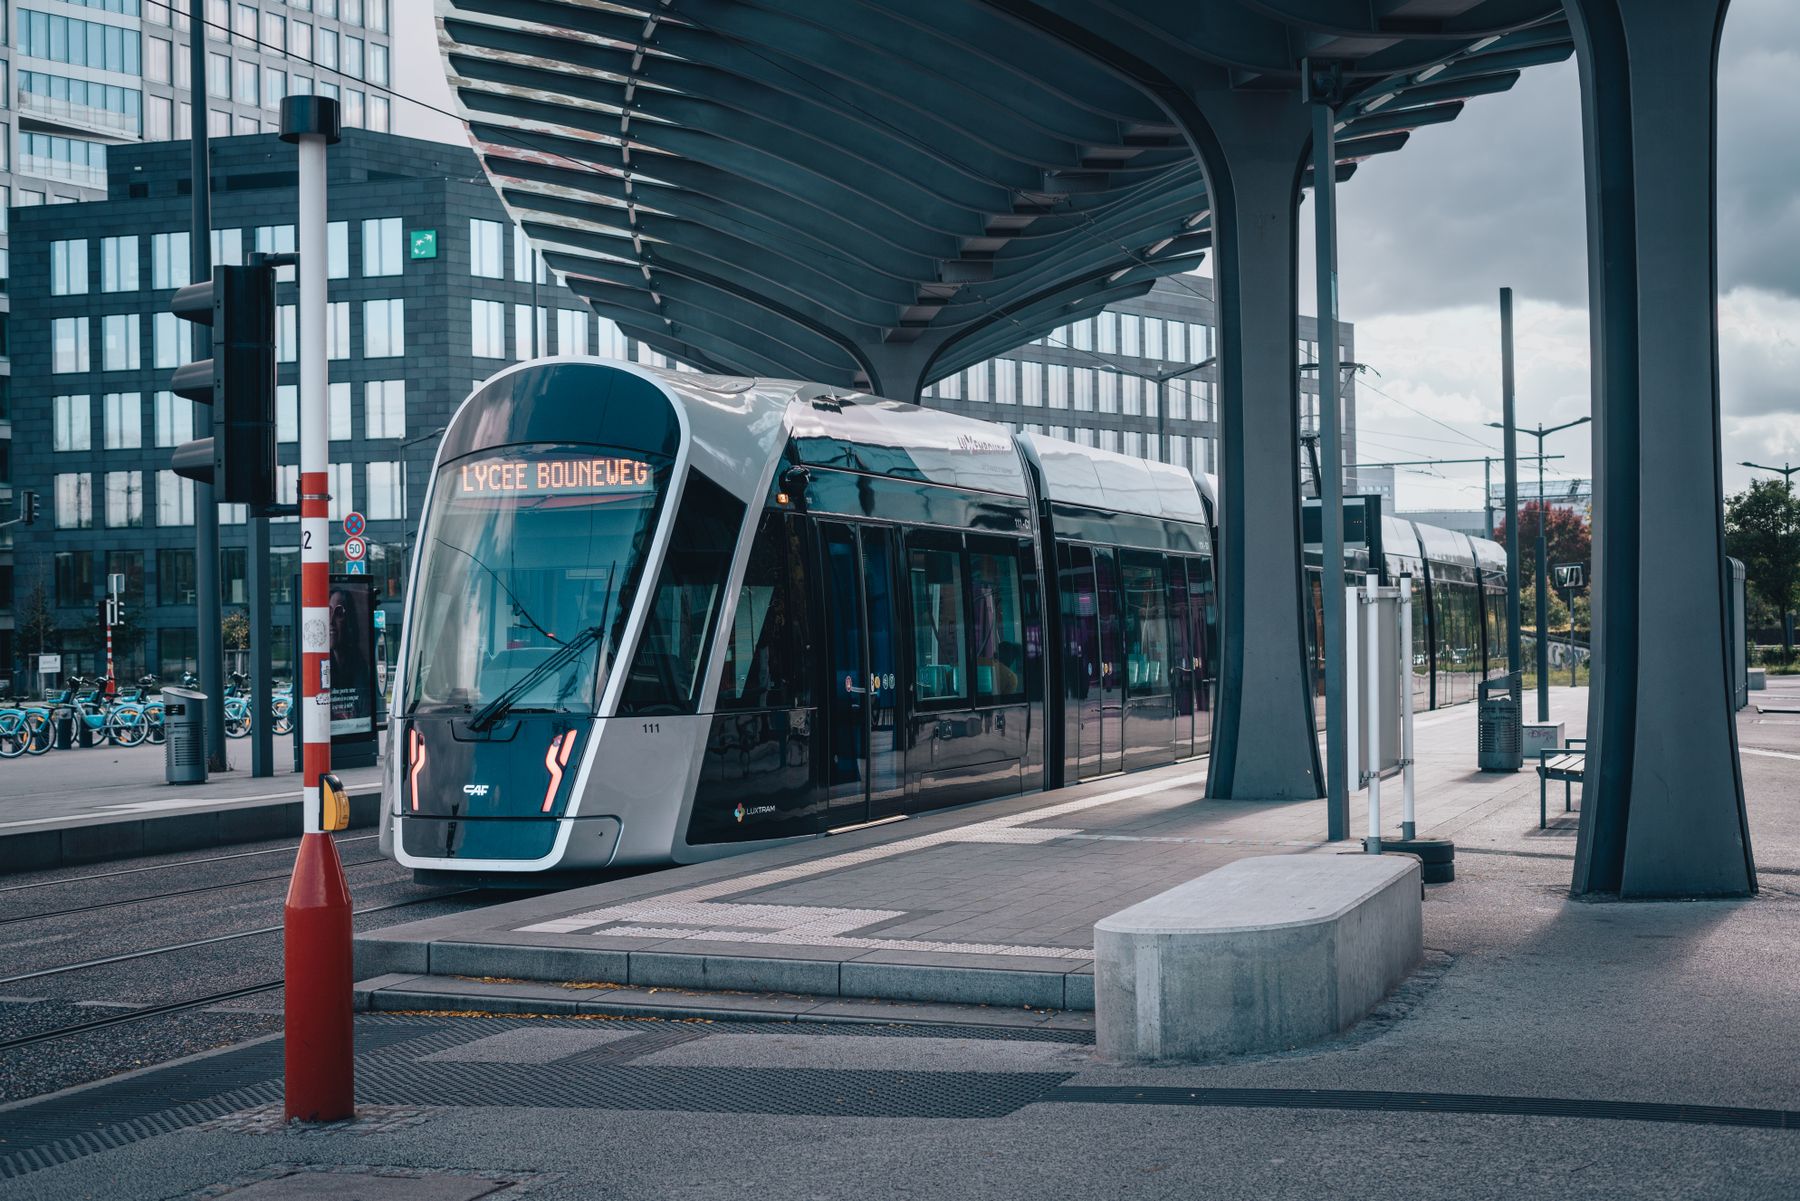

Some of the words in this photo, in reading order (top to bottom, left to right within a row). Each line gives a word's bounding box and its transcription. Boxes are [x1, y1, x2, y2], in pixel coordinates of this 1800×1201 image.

[462, 463, 529, 492] LYCEE
[537, 459, 648, 489] BOUNEWEG
[302, 530, 312, 550] 2
[348, 543, 361, 554] 50
[642, 723, 660, 734] 111
[463, 784, 490, 796] CAF
[746, 804, 776, 816] LUXTRAM
